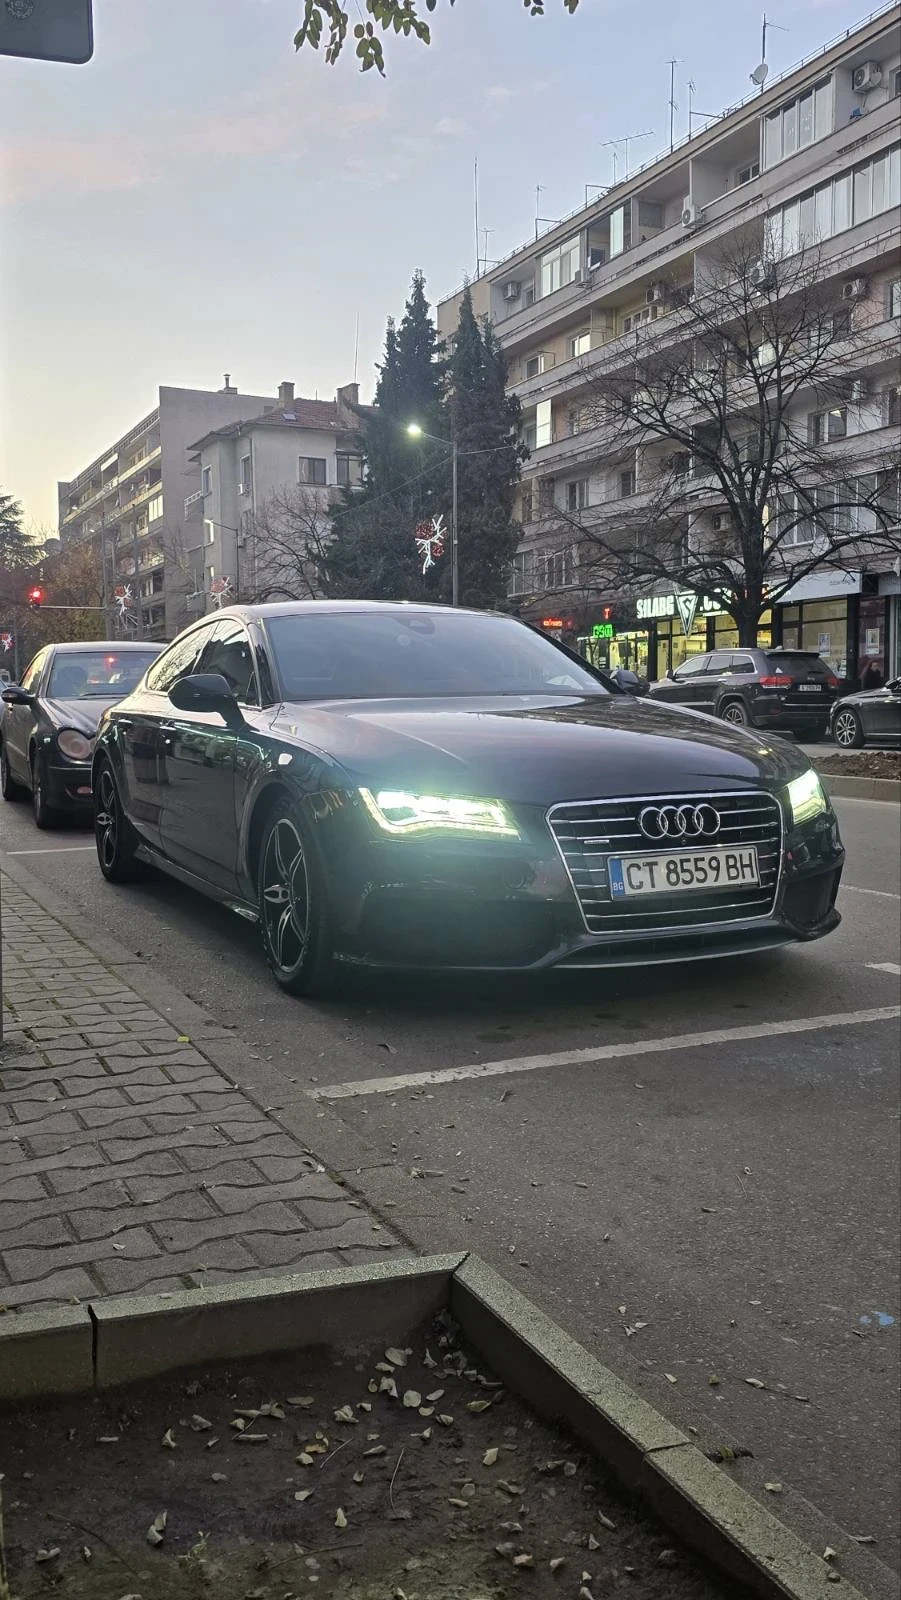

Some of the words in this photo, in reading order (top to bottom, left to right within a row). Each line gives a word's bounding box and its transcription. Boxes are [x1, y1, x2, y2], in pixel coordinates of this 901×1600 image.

[636, 595, 675, 619] SILABG
[626, 861, 659, 890] CT
[665, 855, 721, 887] 8559
[725, 852, 755, 881] BH
[613, 882, 624, 891] BG
